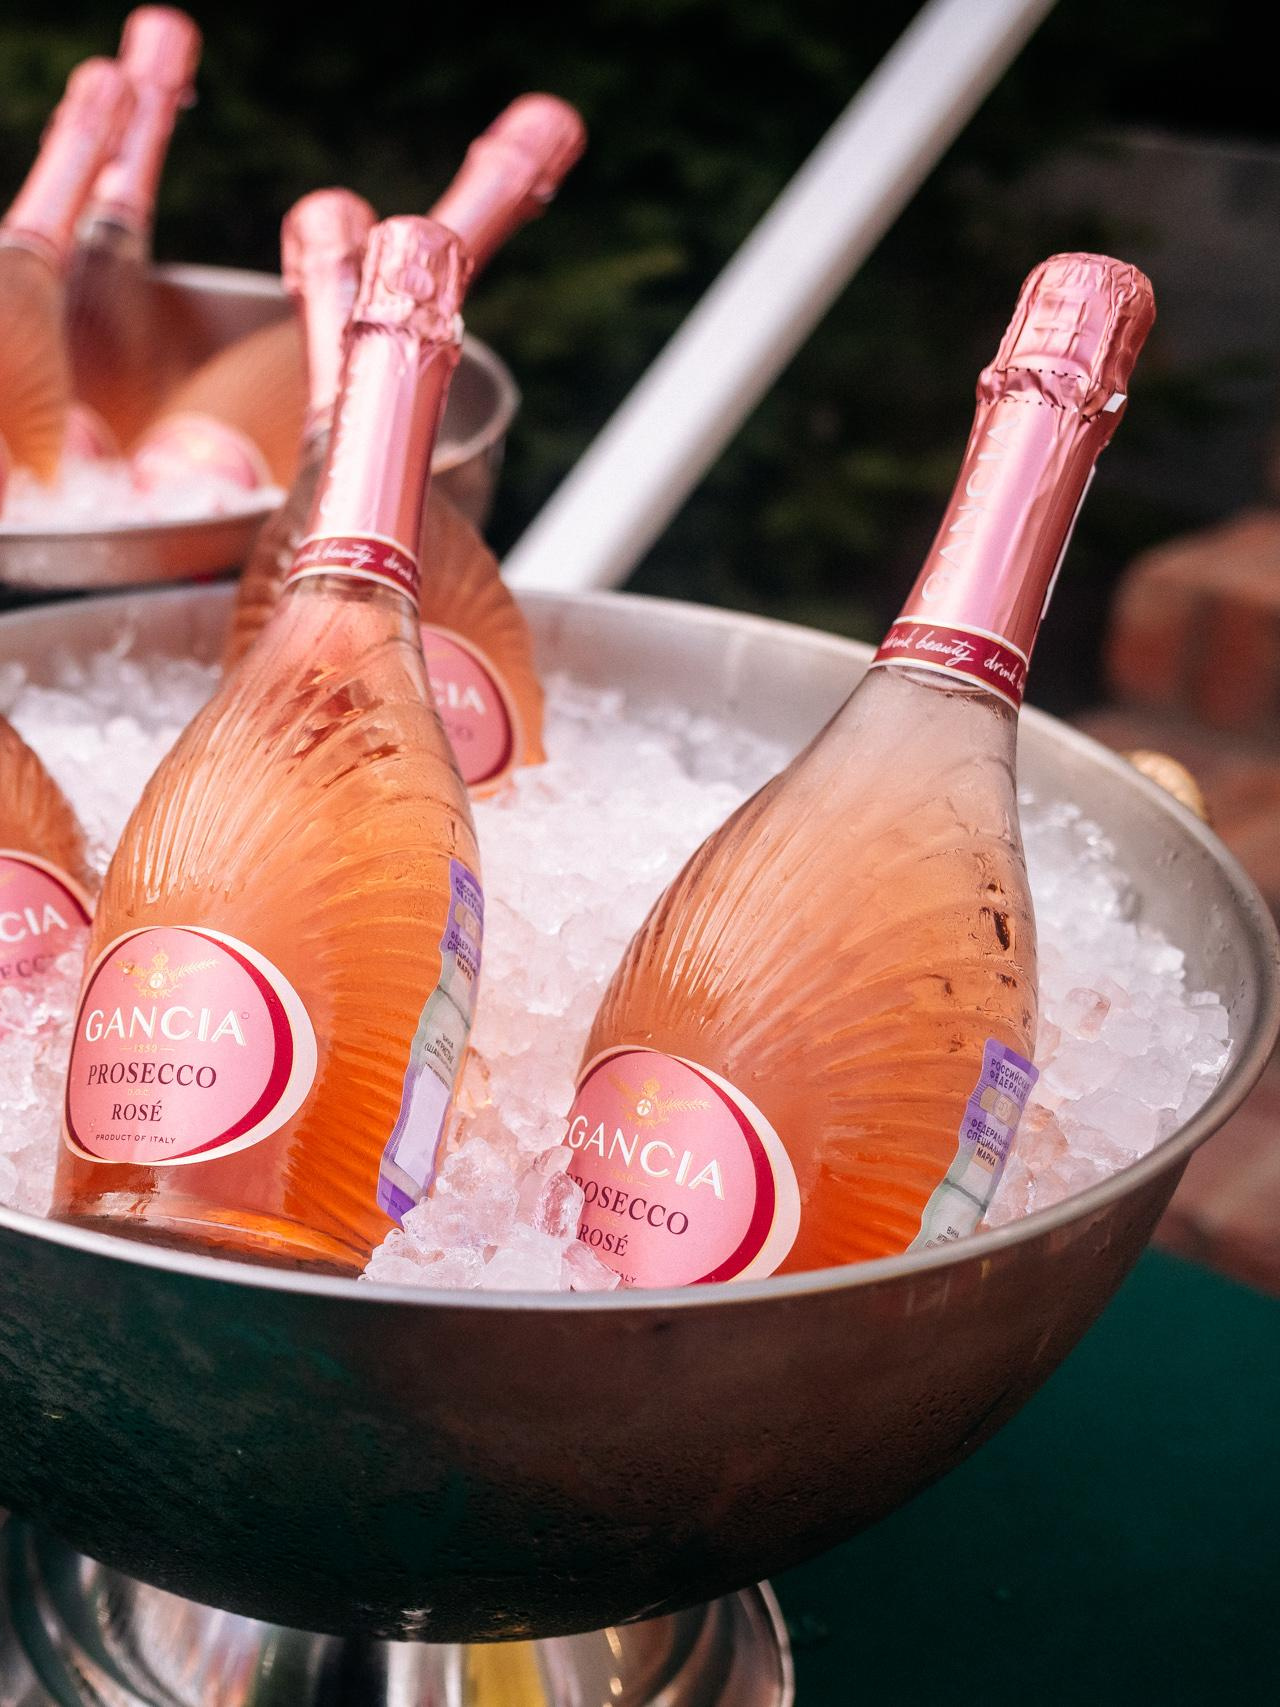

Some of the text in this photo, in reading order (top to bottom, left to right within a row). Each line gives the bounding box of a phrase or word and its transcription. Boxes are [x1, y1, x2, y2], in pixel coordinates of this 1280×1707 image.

[915, 629, 977, 667] beauty
[983, 650, 1019, 687] drink
[85, 1006, 247, 1047] GANCIA
[87, 1062, 217, 1089] PROSECCO
[111, 1100, 163, 1122] ROSÉ
[95, 1134, 132, 1142] PRODUCT
[149, 1135, 176, 1144] ITALY
[568, 1115, 725, 1201] GANCIA
[976, 1147, 996, 1167] МАРКА
[567, 1173, 689, 1235] ROSECCO
[576, 1224, 629, 1257] ROSÉ
